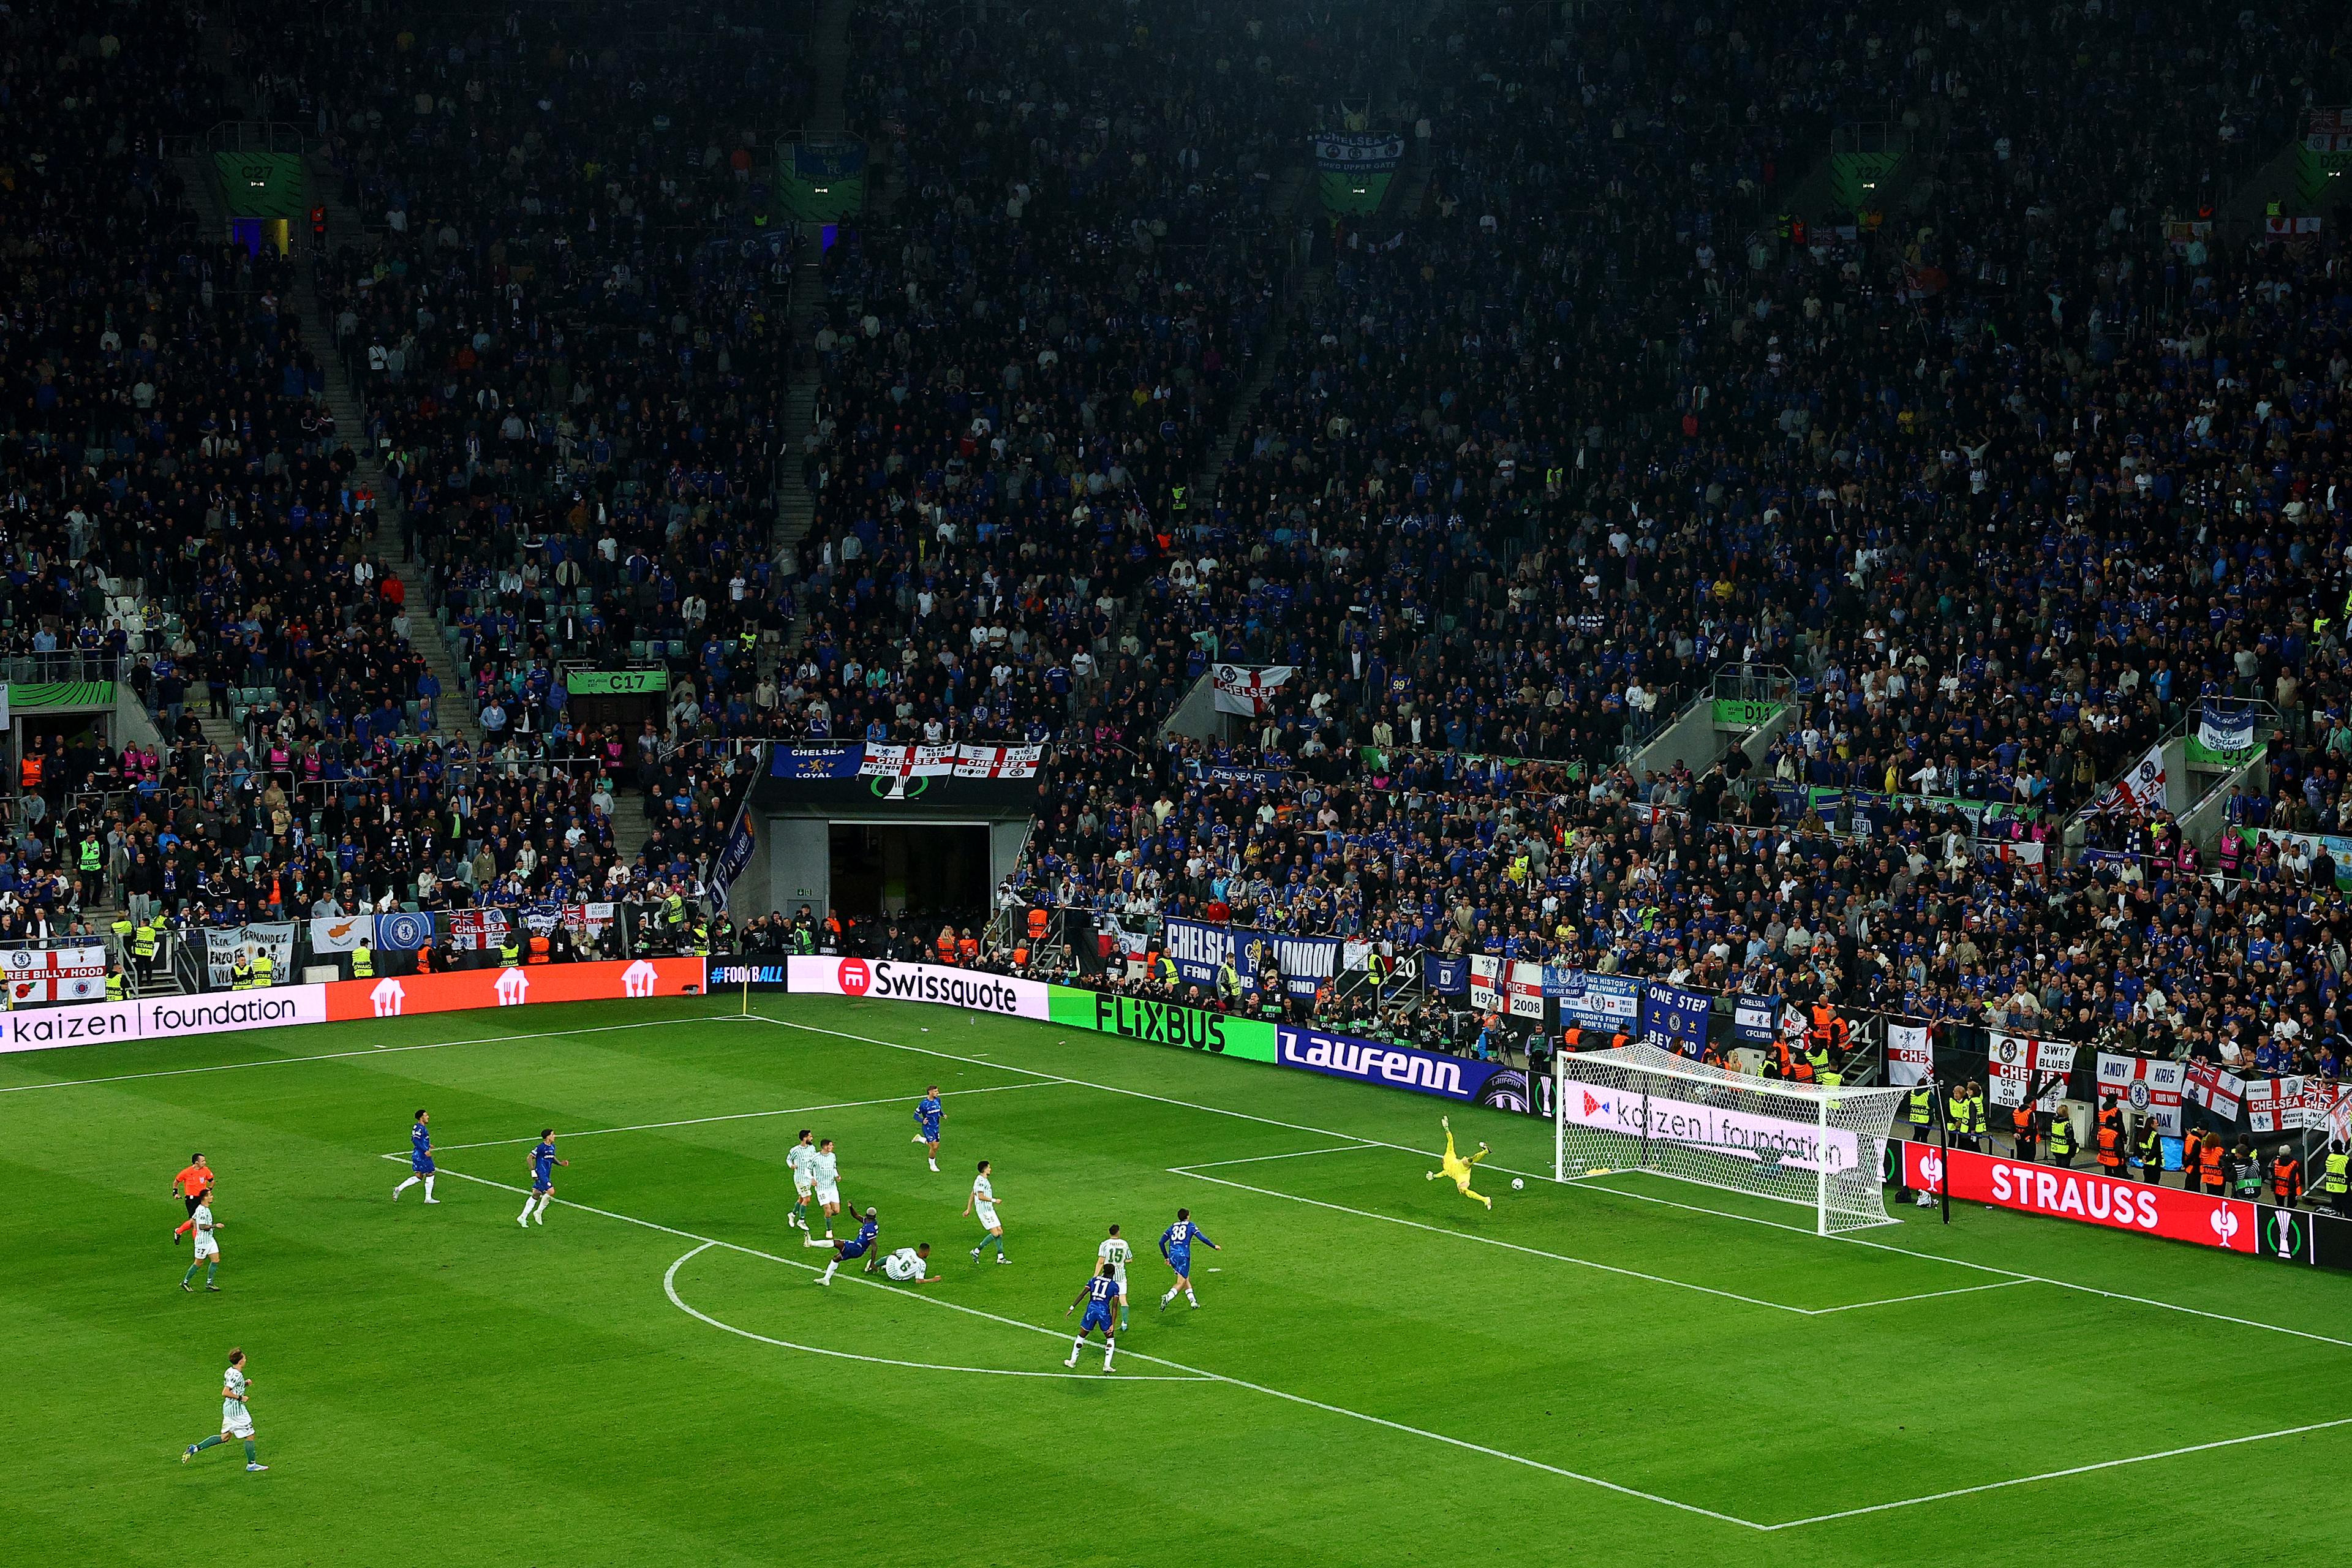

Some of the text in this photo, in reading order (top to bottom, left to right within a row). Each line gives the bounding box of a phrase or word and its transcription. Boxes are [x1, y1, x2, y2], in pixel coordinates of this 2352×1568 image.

[242, 166, 273, 179] C27
[1856, 166, 1882, 179] X22
[609, 675, 646, 690] C17
[1218, 679, 1276, 697] CHELSEA
[1745, 705, 1771, 720] D11
[1212, 769, 1266, 783] CHELSEA FC
[639, 911, 662, 929] 18
[455, 924, 506, 933] CHELSEA
[239, 930, 287, 943] FERNANDEZ
[1167, 924, 1235, 967] CHELSEA
[209, 951, 233, 965] ENZO
[1273, 939, 1337, 978] LONDON
[33, 969, 67, 979] BILLY
[70, 967, 104, 977] HOOD
[1183, 965, 1211, 981] FAN
[1395, 956, 1415, 978] 20
[875, 963, 1017, 1012] Swissquote
[1240, 976, 1254, 989] UB
[1506, 982, 1527, 994] RICE
[1587, 984, 1618, 993] RELIVING
[1600, 978, 1628, 987] HISTORY
[1474, 992, 1499, 1005] 1971
[1649, 986, 1708, 1012] ONE STEP
[1740, 998, 1766, 1008] CHELSEA
[1513, 999, 1540, 1013] 2008
[153, 998, 295, 1029] foundation
[1572, 1012, 1604, 1020] LONDON'S
[13, 1013, 127, 1042] kaizen
[1746, 1029, 1773, 1039] CFCLIBYA
[1849, 1019, 1872, 1043] 21
[1649, 1029, 1697, 1055] BEYND
[2043, 1045, 2070, 1057] SW17
[2039, 1058, 2070, 1069] BLUES
[2103, 1061, 2128, 1078] ANDY
[2154, 1068, 2175, 1083] KRIS
[2000, 1079, 2016, 1088] CFC
[2003, 1088, 2015, 1097] ON
[2155, 1093, 2178, 1103] OUR WAY
[1997, 1096, 2020, 1107] TOUR
[2252, 1097, 2300, 1111] CHELSEA
[1617, 1096, 1842, 1167] kaizen foundation
[1992, 1164, 2158, 1229] STRAUSS
[1170, 1225, 1187, 1241] 38
[1107, 1248, 1123, 1263] 15
[900, 1261, 911, 1272] 6
[1091, 1280, 1109, 1298] 11
